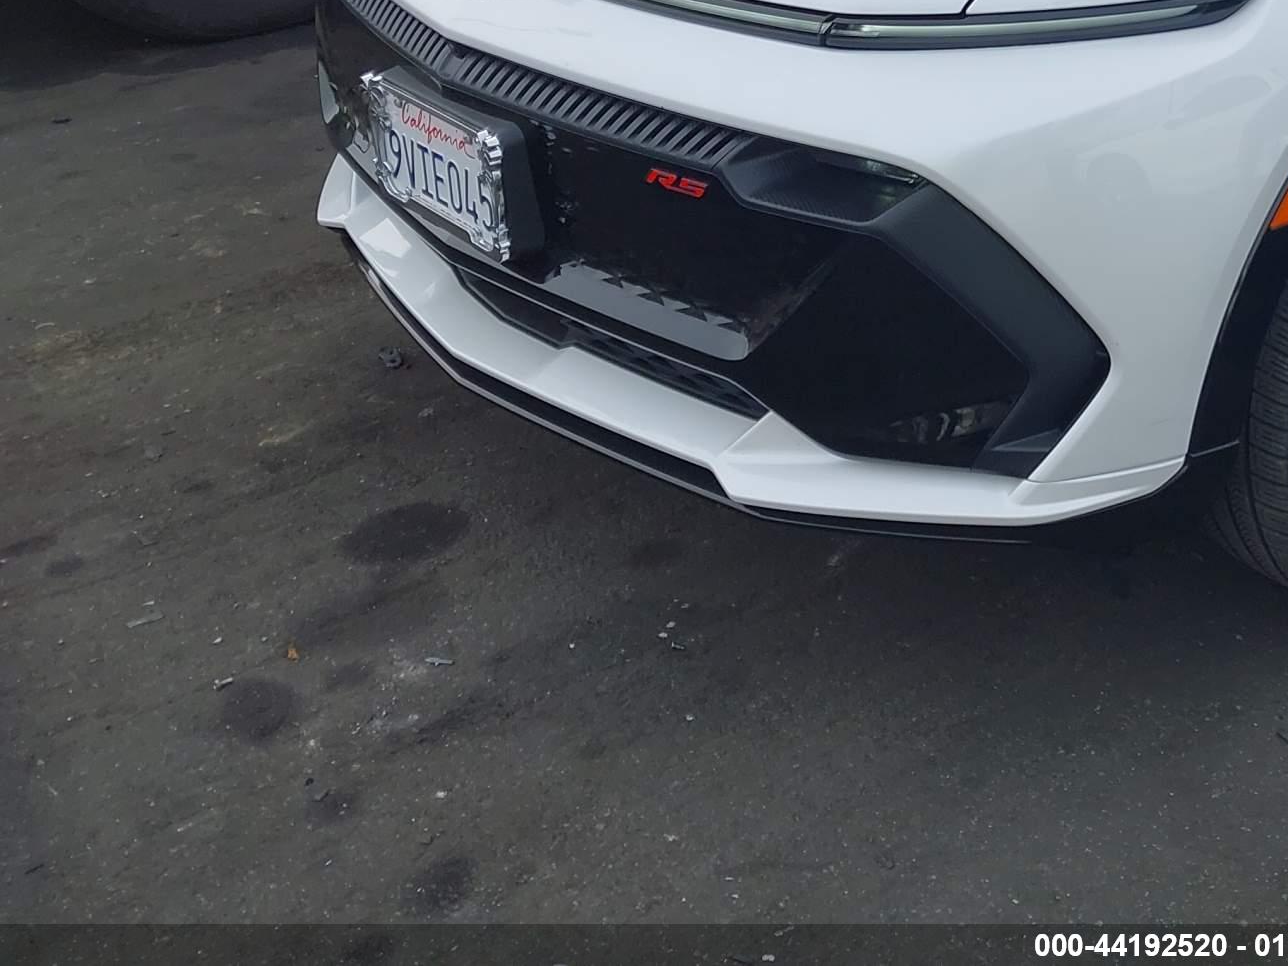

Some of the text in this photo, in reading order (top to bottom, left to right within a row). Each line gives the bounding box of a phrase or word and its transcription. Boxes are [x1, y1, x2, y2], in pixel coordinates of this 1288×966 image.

[401, 103, 476, 160] California
[389, 129, 497, 231] 9VIE045
[646, 168, 708, 198] RS
